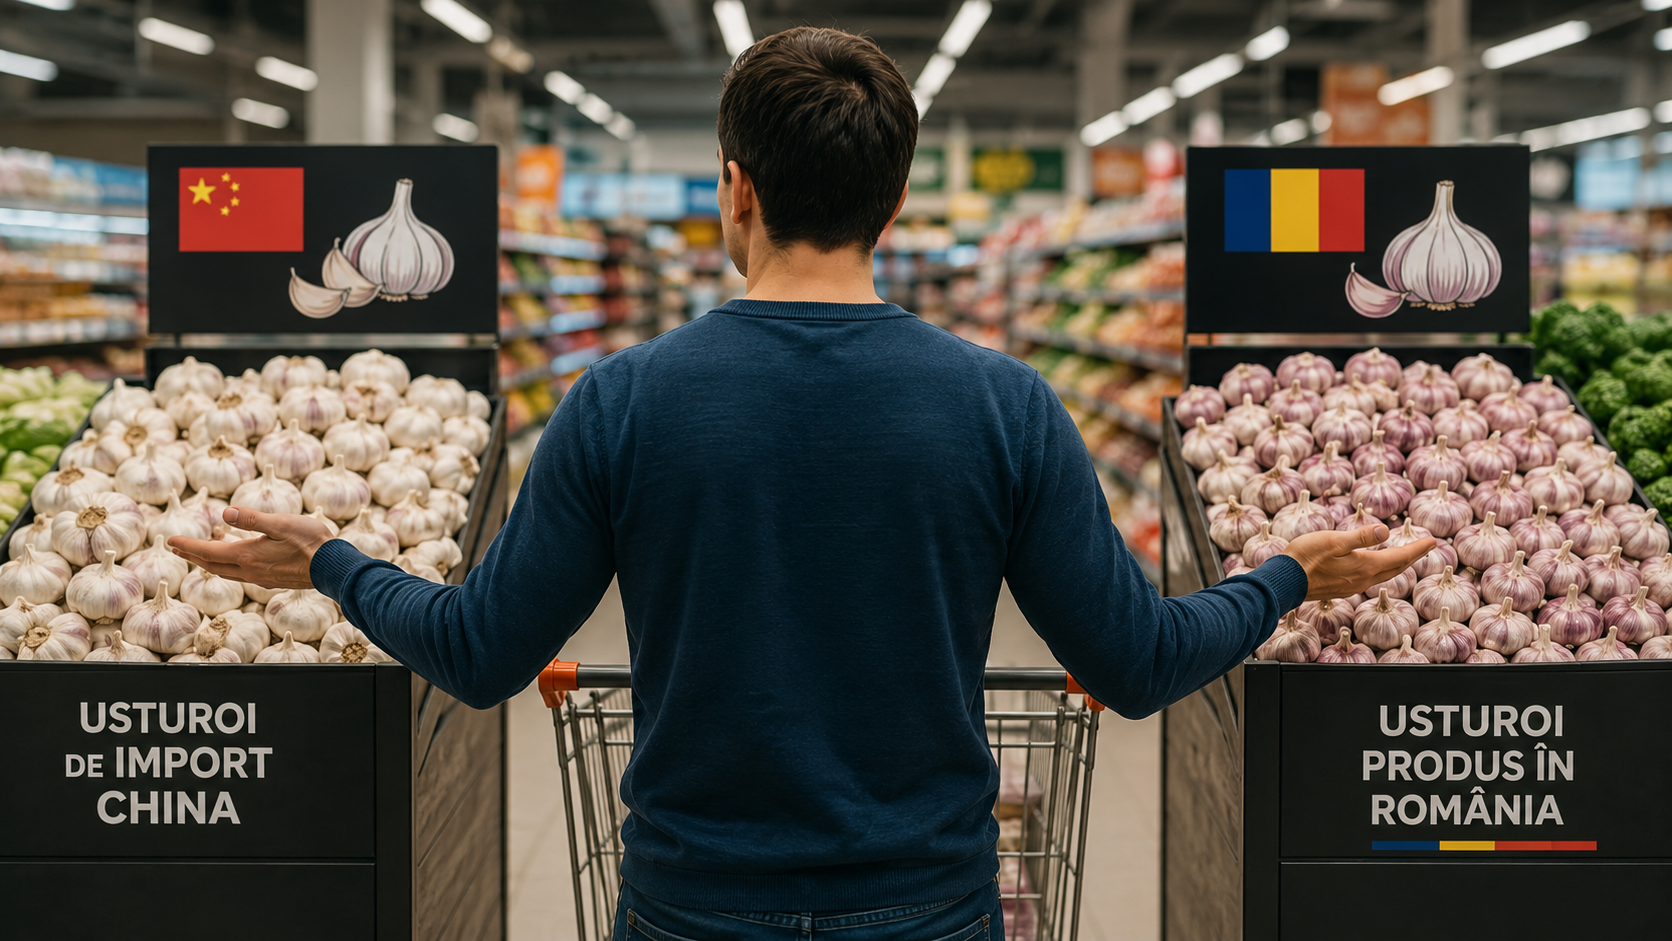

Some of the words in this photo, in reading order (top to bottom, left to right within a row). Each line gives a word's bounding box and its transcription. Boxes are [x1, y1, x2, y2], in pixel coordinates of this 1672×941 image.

[80, 701, 256, 734] USTUROI
[1379, 704, 1563, 737] USTUROI
[65, 753, 104, 778] DE
[115, 746, 273, 779] IMPORT
[1362, 749, 1525, 782] PRODUS
[1534, 742, 1574, 781] ÎN
[96, 790, 241, 825] CHINA
[1371, 786, 1565, 826] ROMÂNIA
